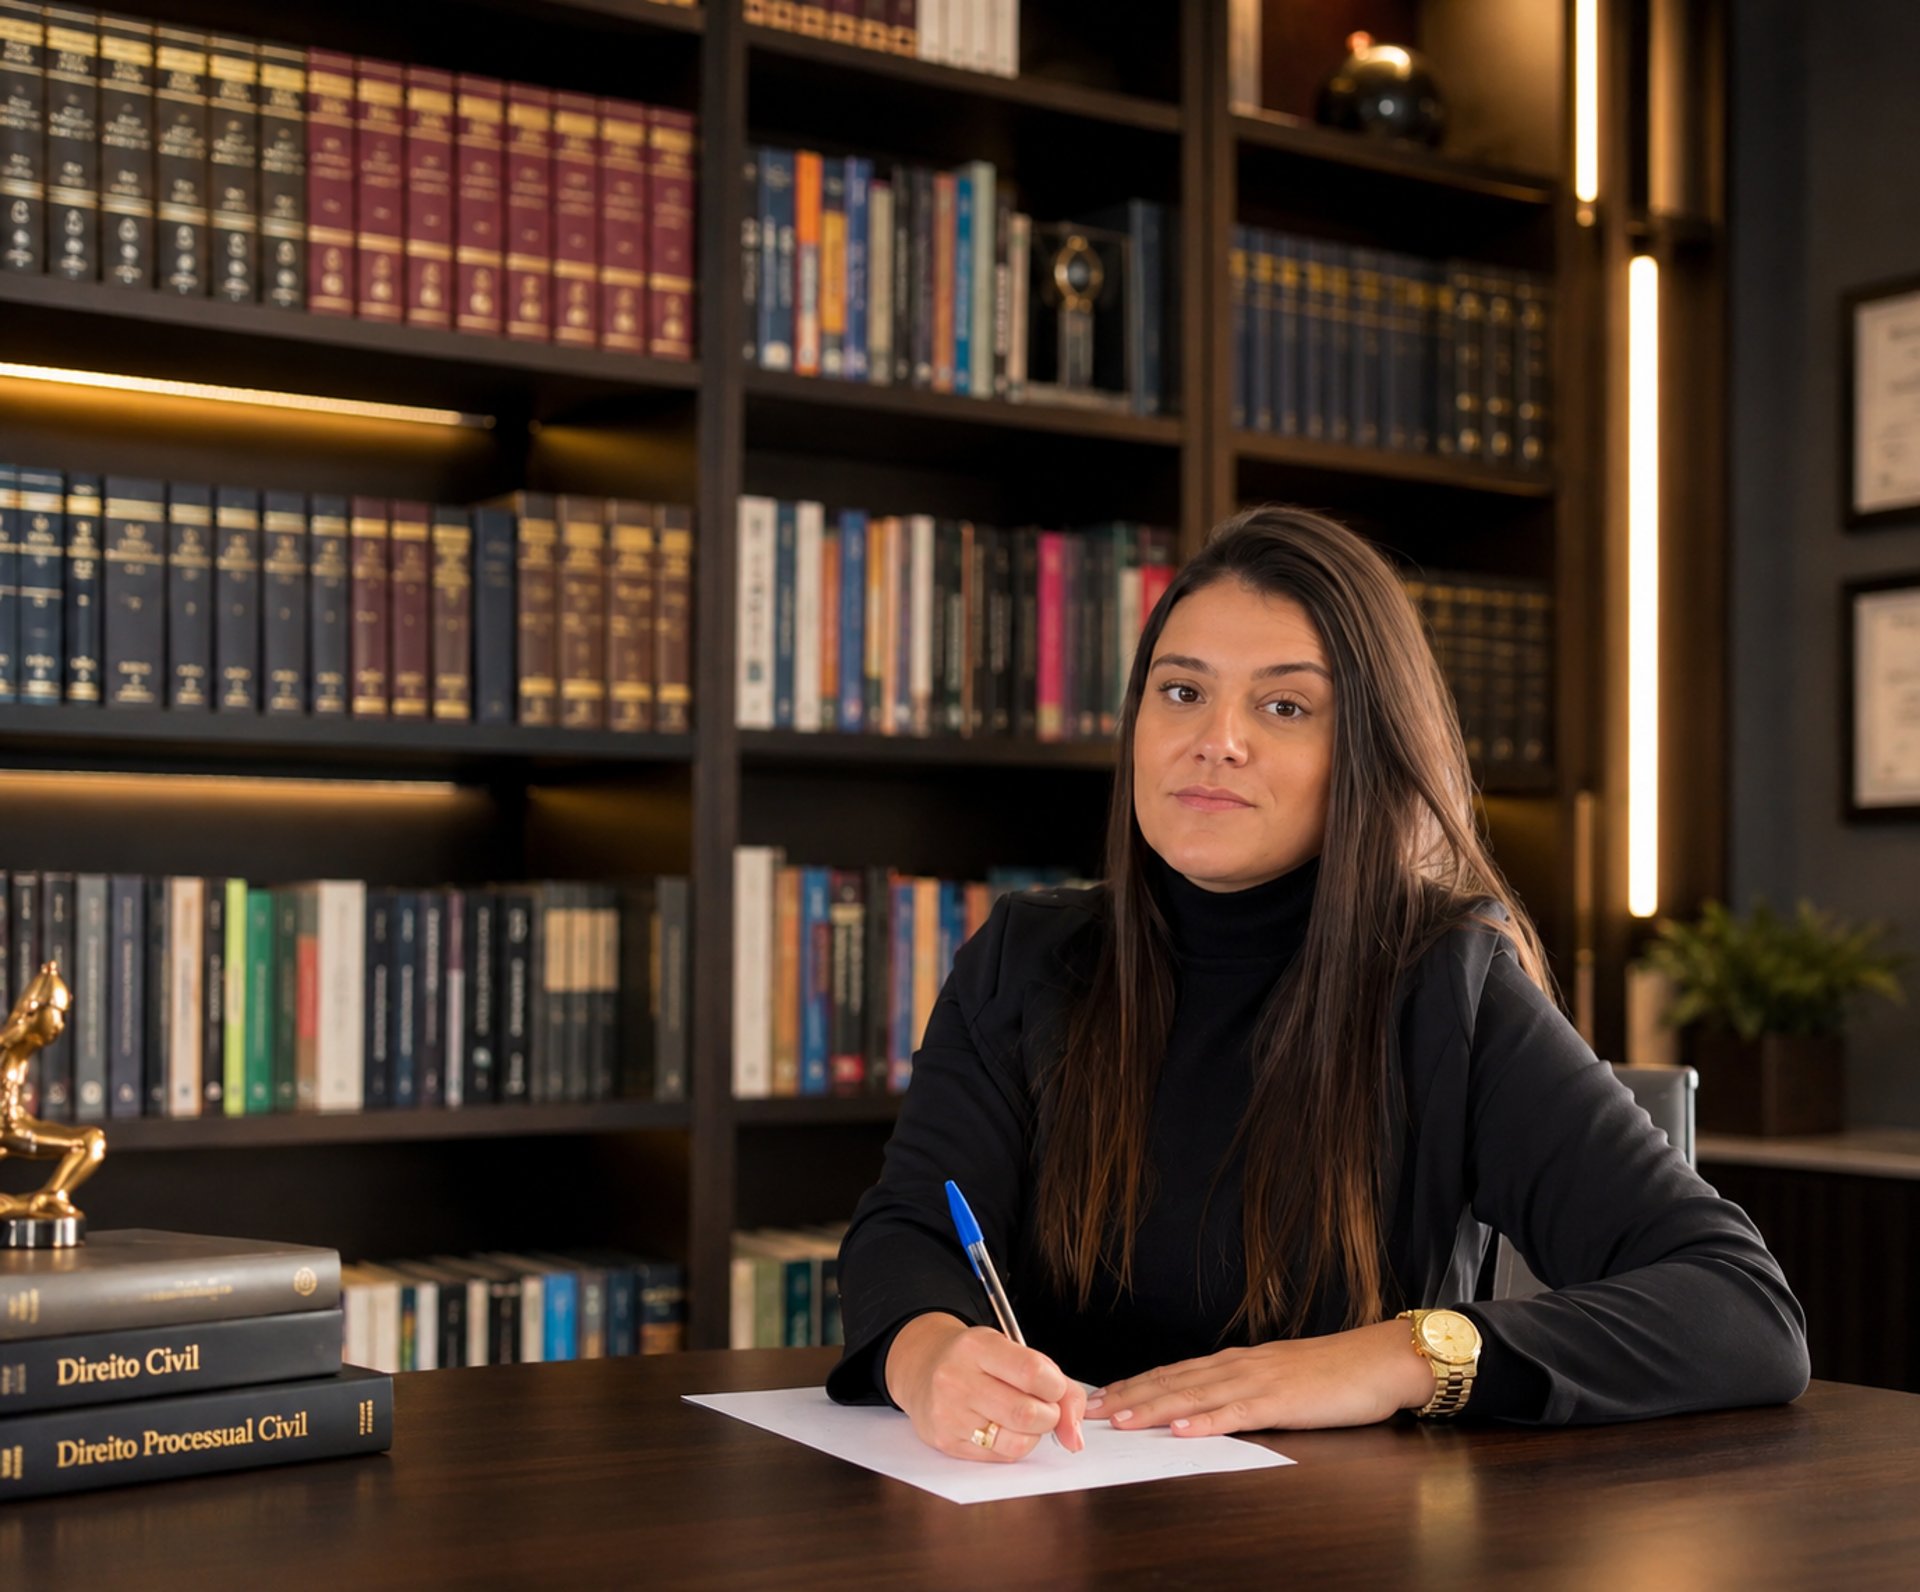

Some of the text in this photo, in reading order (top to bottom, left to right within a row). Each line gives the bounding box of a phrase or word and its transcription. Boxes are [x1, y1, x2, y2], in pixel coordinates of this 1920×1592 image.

[57, 1354, 141, 1386] Direito
[145, 1344, 200, 1375] Civil
[57, 1435, 138, 1468] Direito
[143, 1418, 254, 1457] Processual
[258, 1411, 308, 1441] Civil
